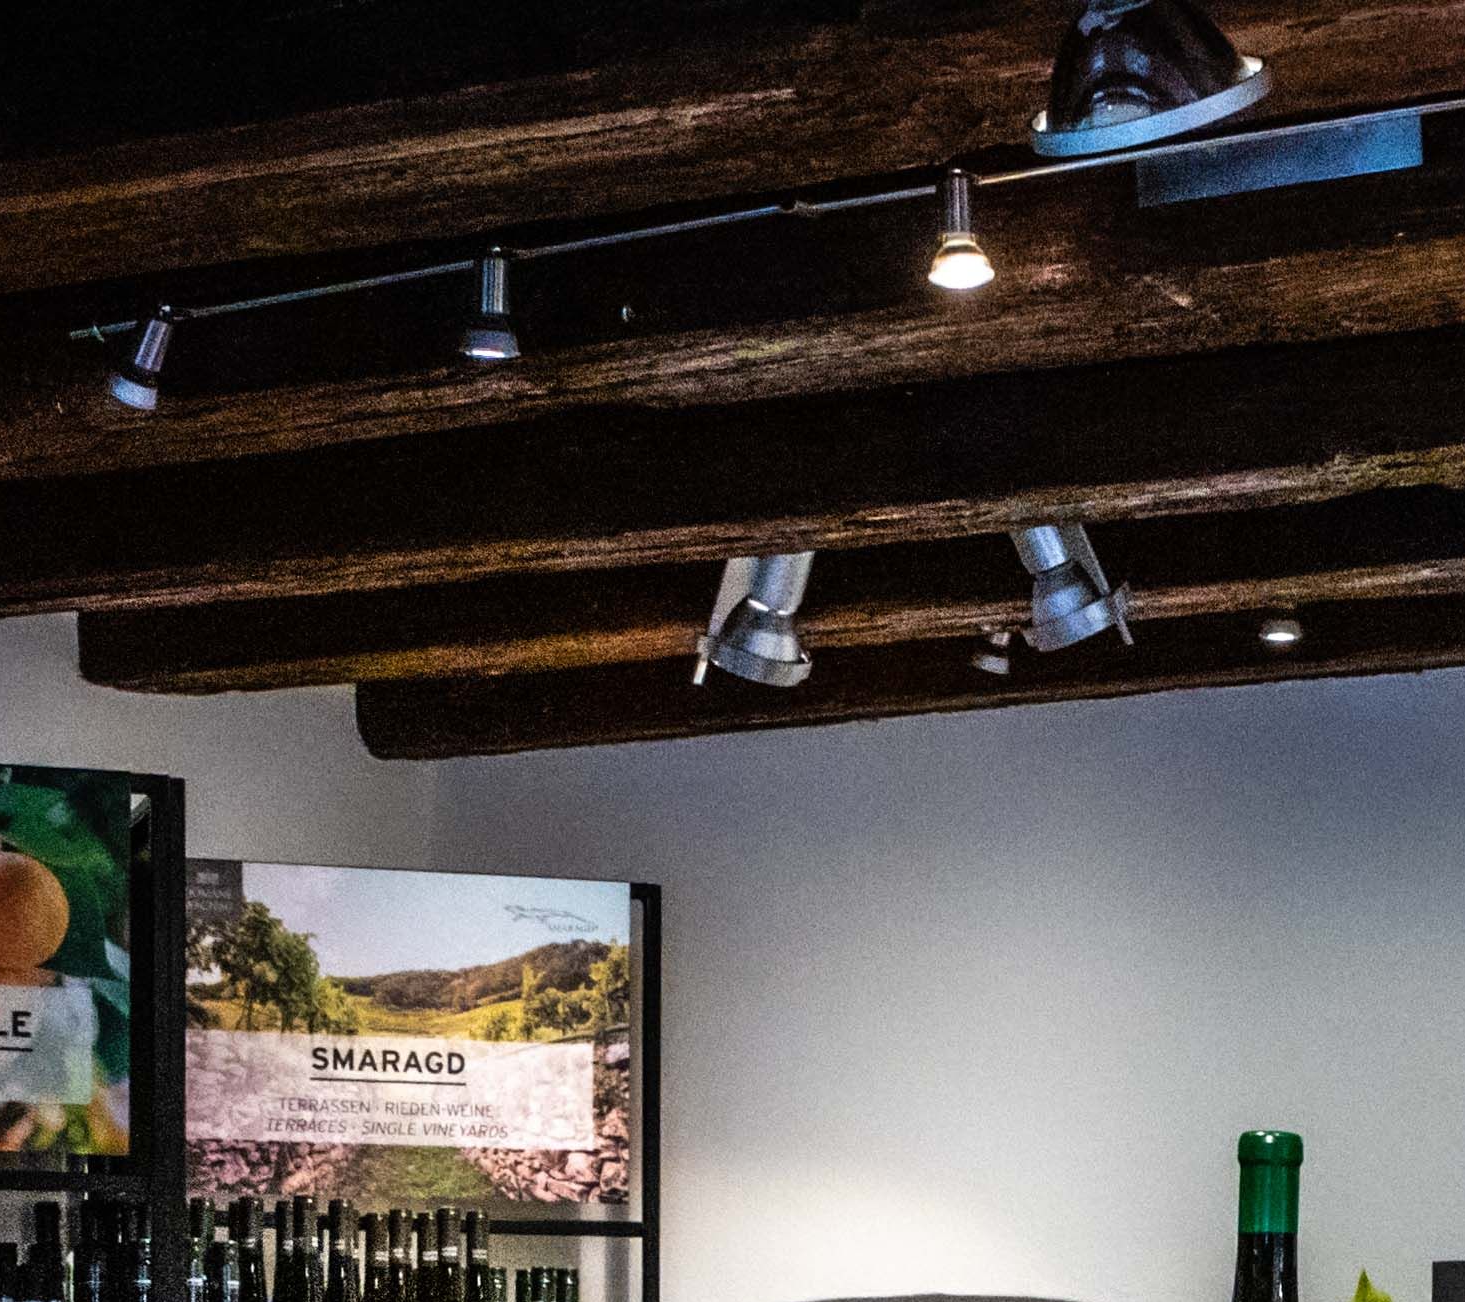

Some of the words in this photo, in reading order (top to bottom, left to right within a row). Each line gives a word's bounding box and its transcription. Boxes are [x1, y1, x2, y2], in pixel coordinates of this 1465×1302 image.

[311, 1047, 466, 1075] SMARAGD
[277, 1096, 371, 1115] TERRASSEN
[266, 1118, 348, 1135] TERRACES
[361, 1121, 416, 1137] SINGLE
[422, 1122, 510, 1140] VINEYARDS
